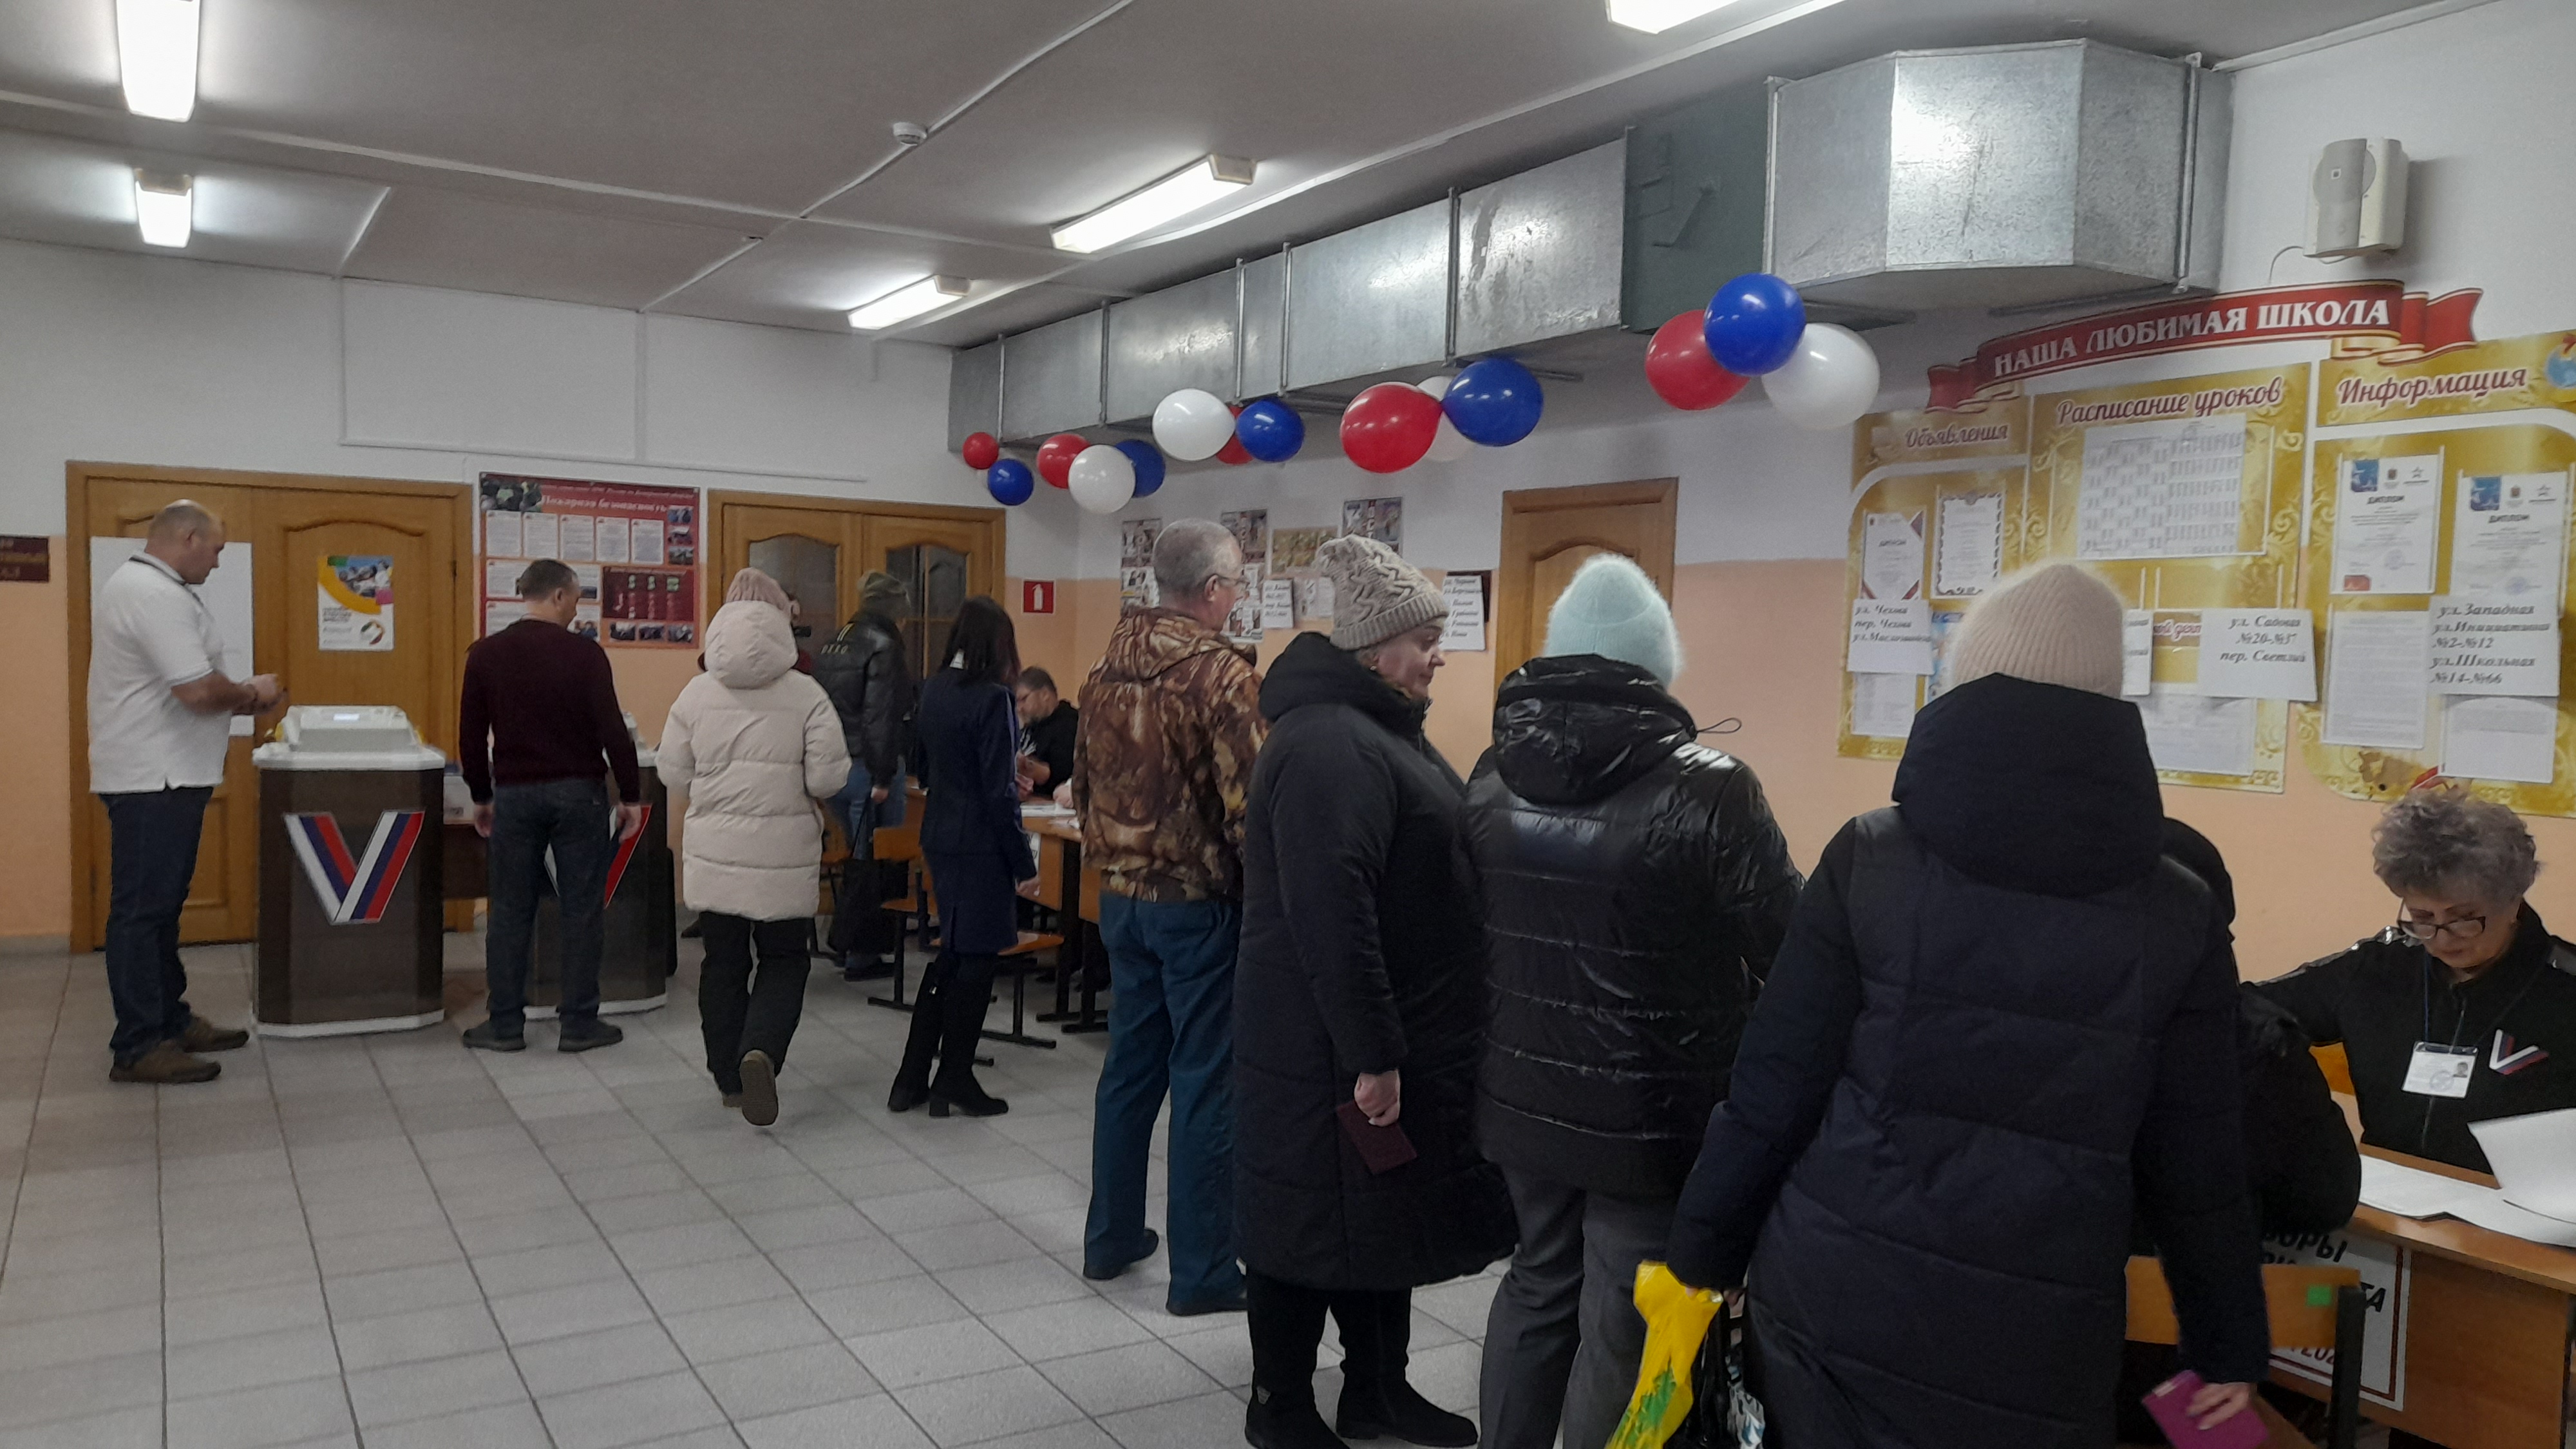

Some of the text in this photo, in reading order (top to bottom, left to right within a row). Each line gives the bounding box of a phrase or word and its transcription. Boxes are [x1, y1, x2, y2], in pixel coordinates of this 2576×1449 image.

[1994, 299, 2390, 377] НАША ЛЮБИМАЯ ШКОЛА
[2057, 376, 2284, 425] Расписание уроков
[2338, 368, 2526, 407] Информация
[1905, 424, 2009, 448] Объявления
[2220, 652, 2248, 664] пер.
